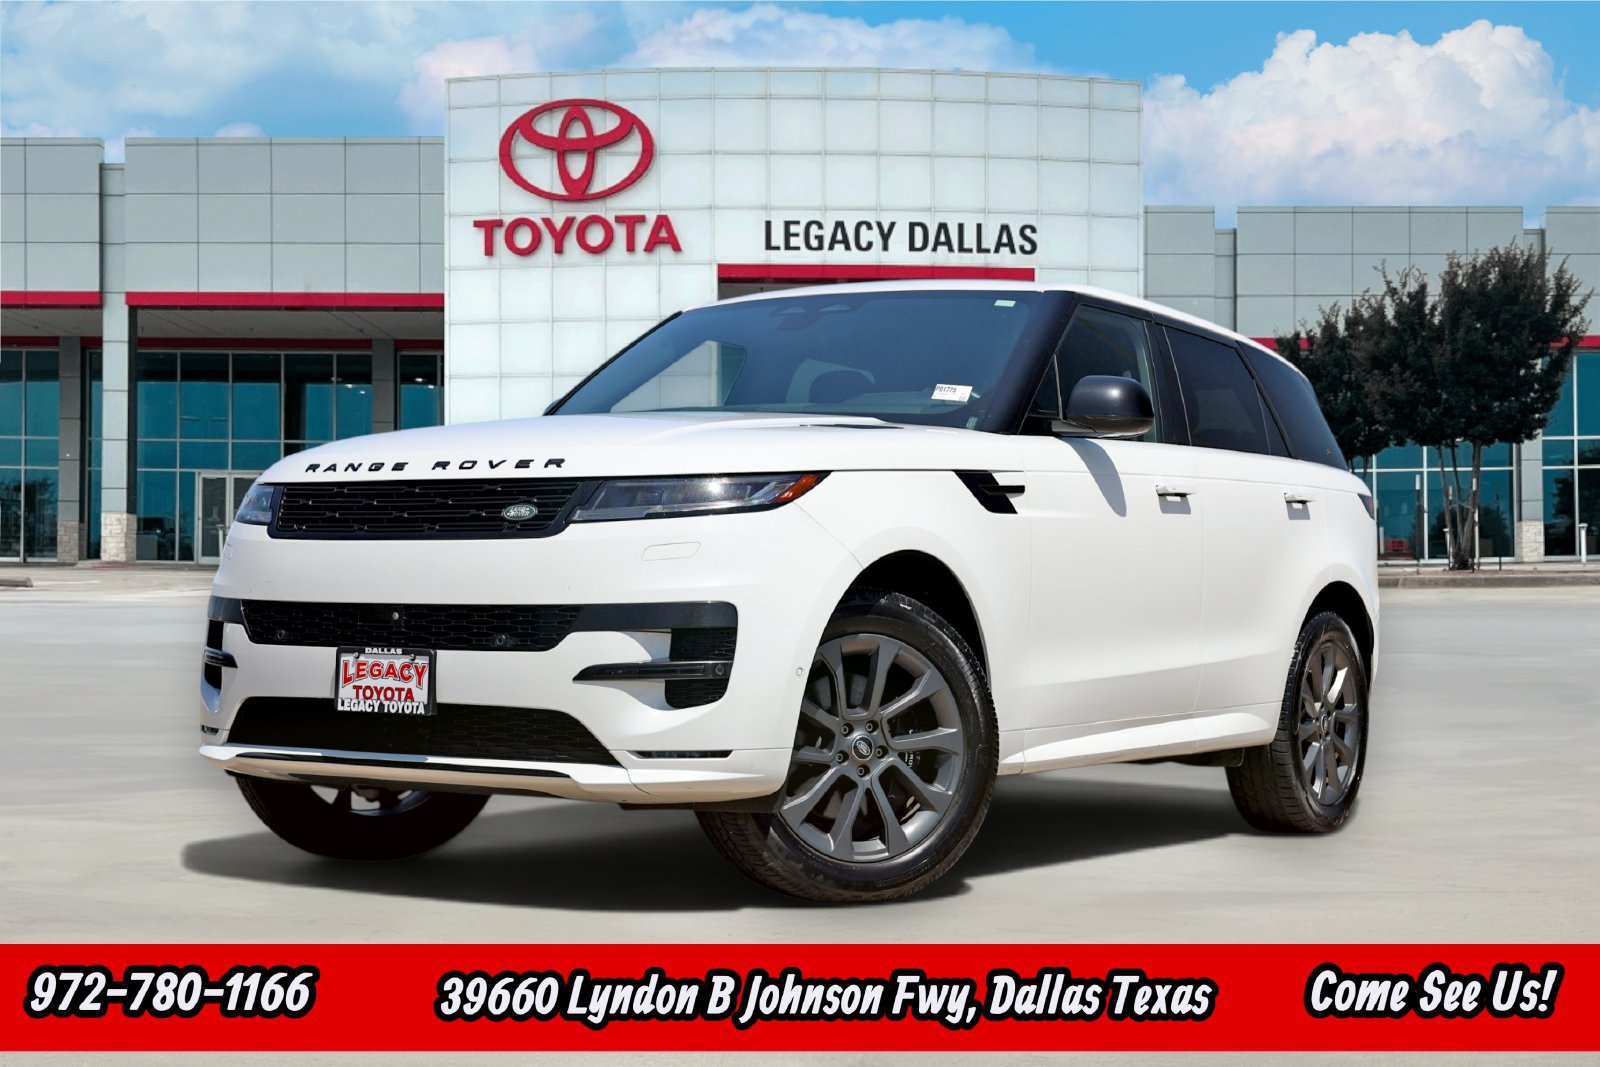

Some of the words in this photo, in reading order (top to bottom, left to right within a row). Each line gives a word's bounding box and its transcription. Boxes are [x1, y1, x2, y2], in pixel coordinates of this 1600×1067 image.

[474, 213, 682, 257] TOYOTA
[764, 220, 896, 252] LEGACY
[907, 221, 1038, 255] DALLAS
[305, 462, 409, 473] RANGE
[431, 458, 566, 471] ROVER
[365, 647, 402, 655] DALLAS
[342, 660, 428, 690] LEGACY
[353, 685, 415, 702] TOYOTA
[337, 698, 380, 713] LEGACY
[382, 700, 425, 715] TOYOTA
